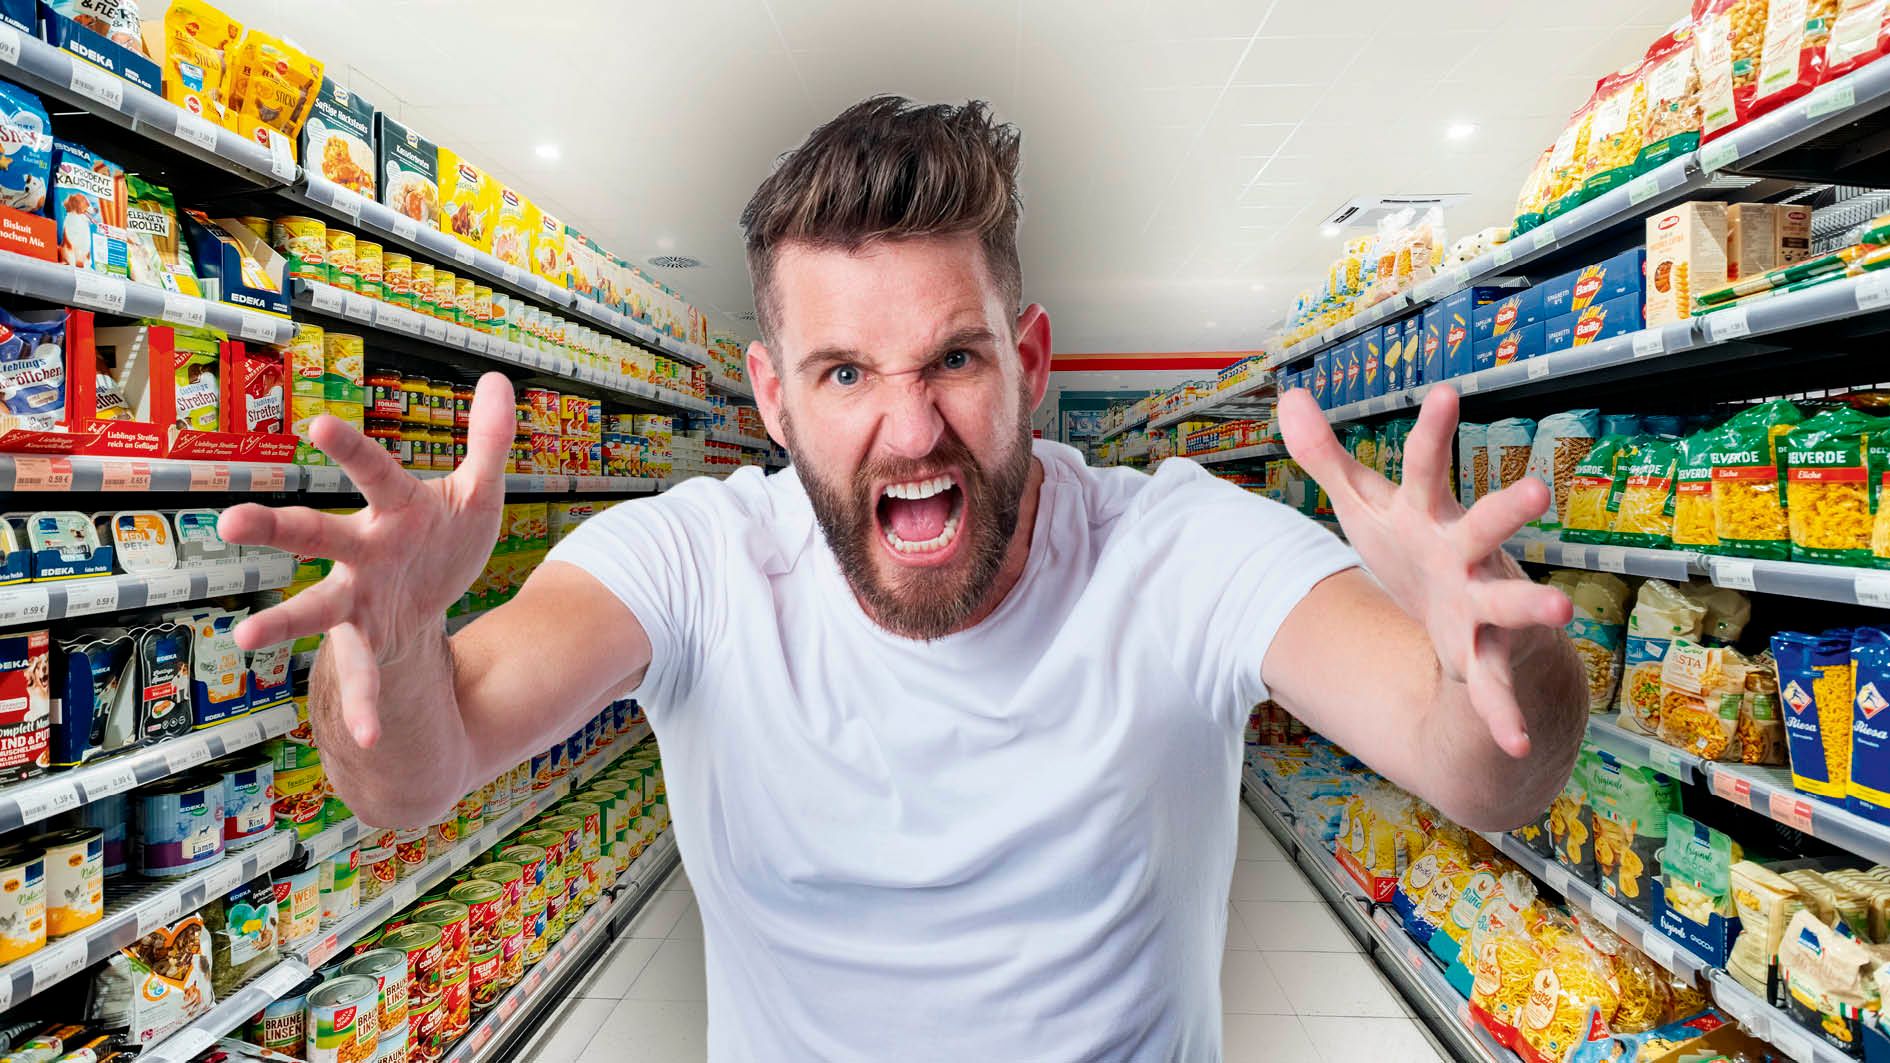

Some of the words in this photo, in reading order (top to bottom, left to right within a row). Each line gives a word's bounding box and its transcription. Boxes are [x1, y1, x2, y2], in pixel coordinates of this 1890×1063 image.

[69, 40, 114, 71] EDEKA
[314, 98, 337, 117] Saftige
[73, 166, 111, 186] PRODENT
[55, 175, 112, 197] KAUSTICKS
[3, 218, 31, 235] Biskuit
[29, 237, 45, 249] Mix
[1576, 280, 1599, 296] Barilla
[231, 293, 266, 308] EDEKA
[1577, 321, 1600, 336] Barilla
[0, 358, 47, 373] ieblings
[176, 391, 218, 411] Streifen
[107, 431, 136, 442] Lieblings
[137, 433, 159, 442] Streifen
[107, 440, 123, 448] reich
[41, 567, 75, 577] EDEKA
[23, 606, 39, 616] 0.59
[0, 659, 29, 670] DEKA
[156, 654, 177, 664] EDEKA
[1678, 654, 1701, 669] STA
[1787, 716, 1818, 732] Riesa
[1853, 720, 1889, 740] Riesa
[1, 735, 26, 750] IND
[234, 783, 257, 792] EDEKA
[178, 803, 205, 813] EDEKA
[248, 817, 264, 828] Rind
[192, 842, 214, 854] Lamm
[230, 889, 252, 902] EDEKA
[473, 958, 497, 972] FEUER
[265, 1013, 301, 1030] BRAUNE
[265, 1023, 302, 1041] LINSEN
